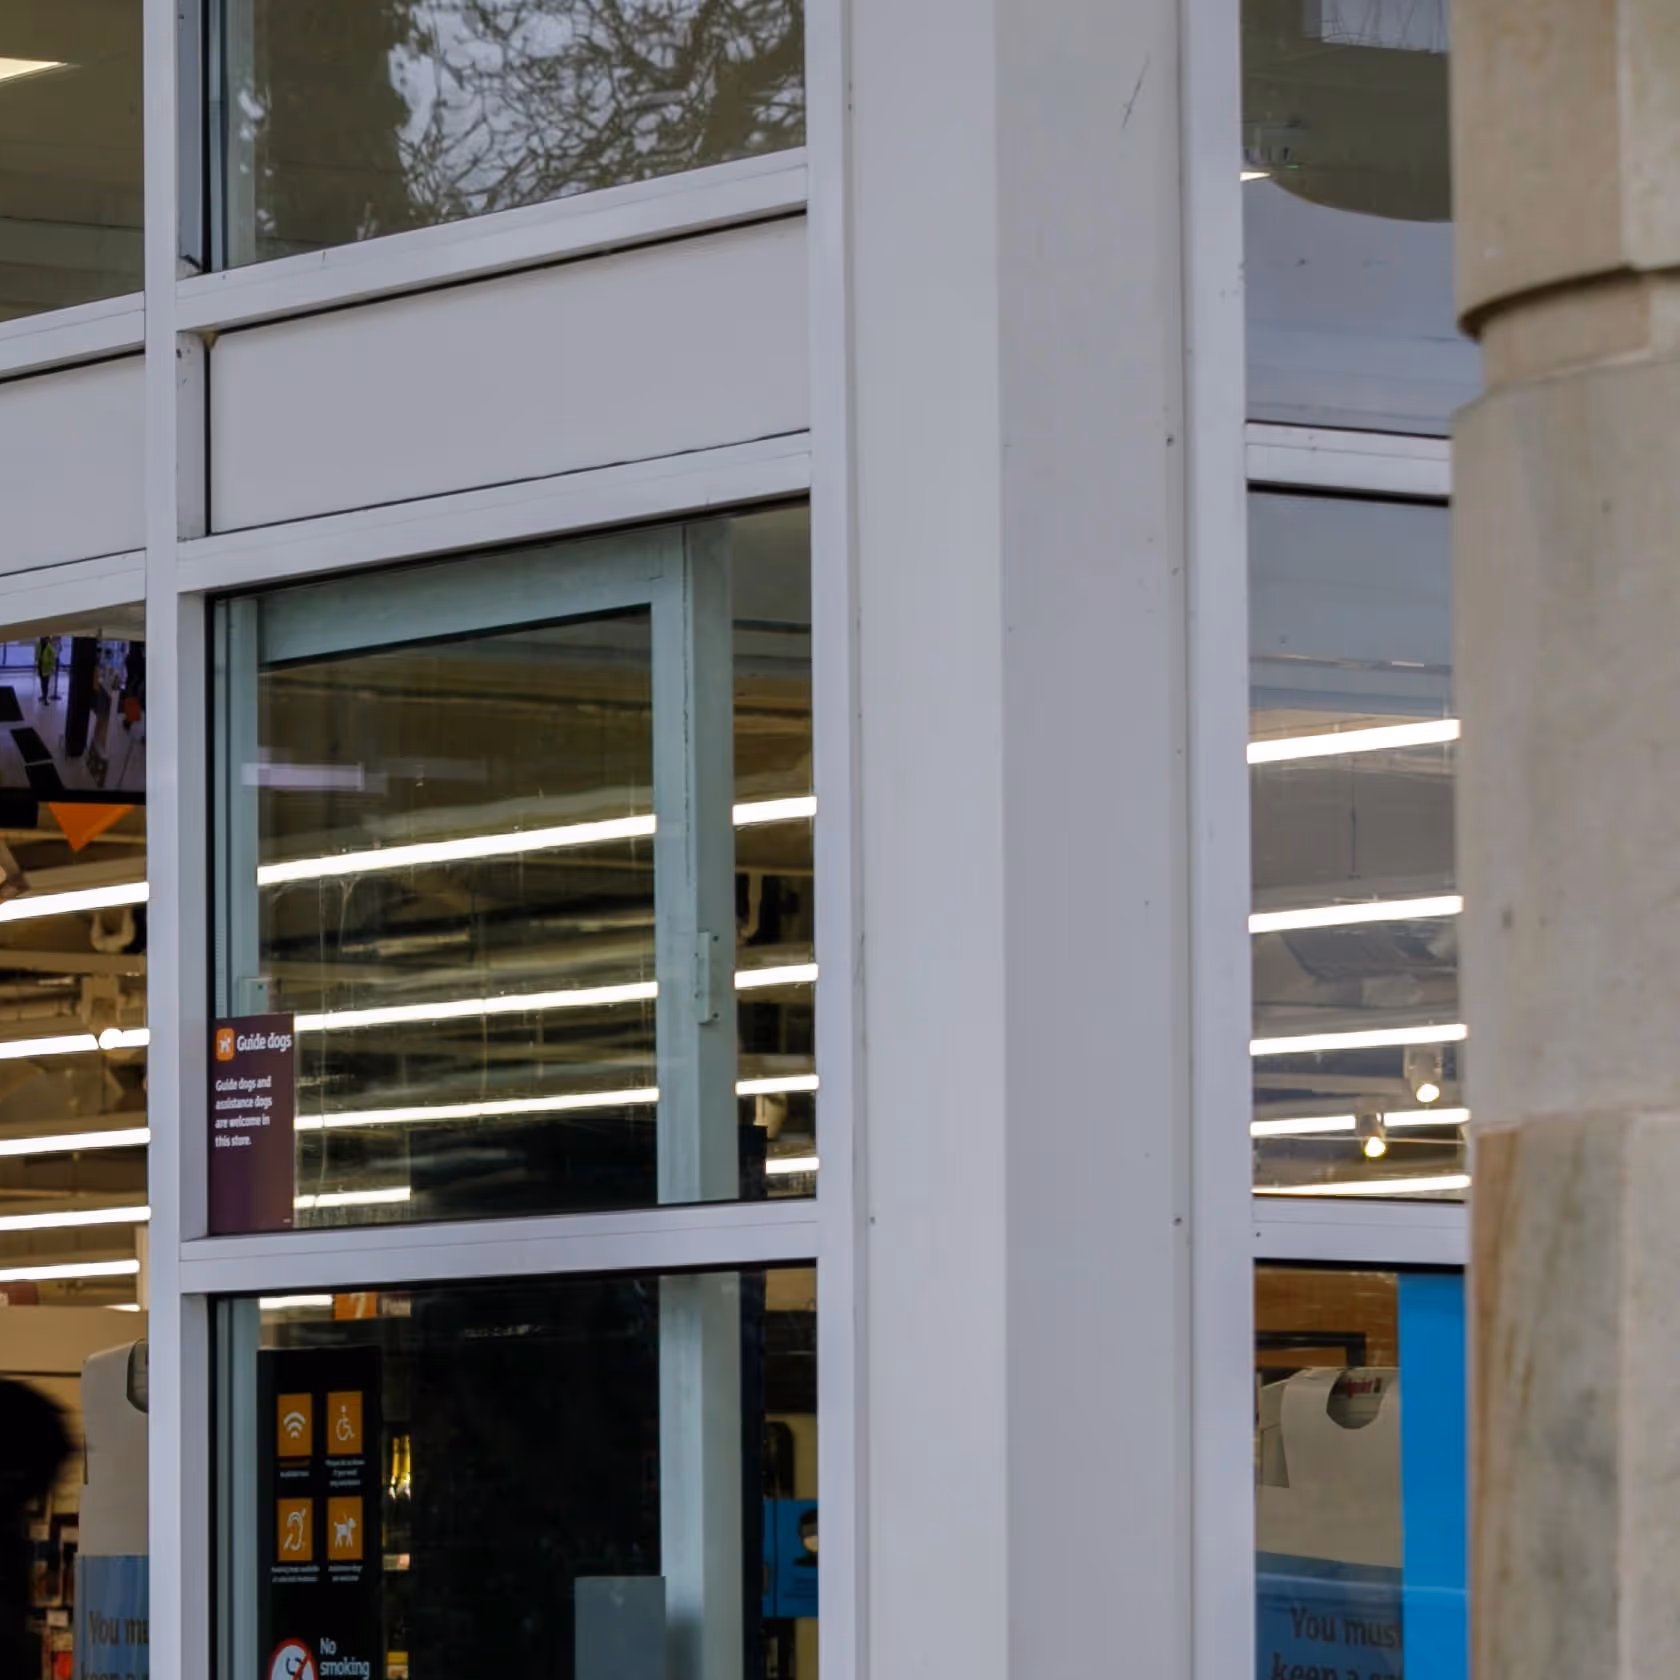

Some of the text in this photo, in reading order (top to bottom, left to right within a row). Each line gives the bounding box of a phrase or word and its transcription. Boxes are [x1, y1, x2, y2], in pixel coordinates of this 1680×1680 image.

[237, 1032, 292, 1053] Guide dogs
[215, 1079, 237, 1092] Guide
[257, 1075, 272, 1088] and
[215, 1117, 227, 1128] are
[229, 1114, 261, 1128] welcome
[215, 1134, 230, 1147] this
[88, 1610, 120, 1645] You
[1290, 1604, 1336, 1643] You
[320, 1636, 337, 1655] No
[320, 1656, 370, 1680] smoking
